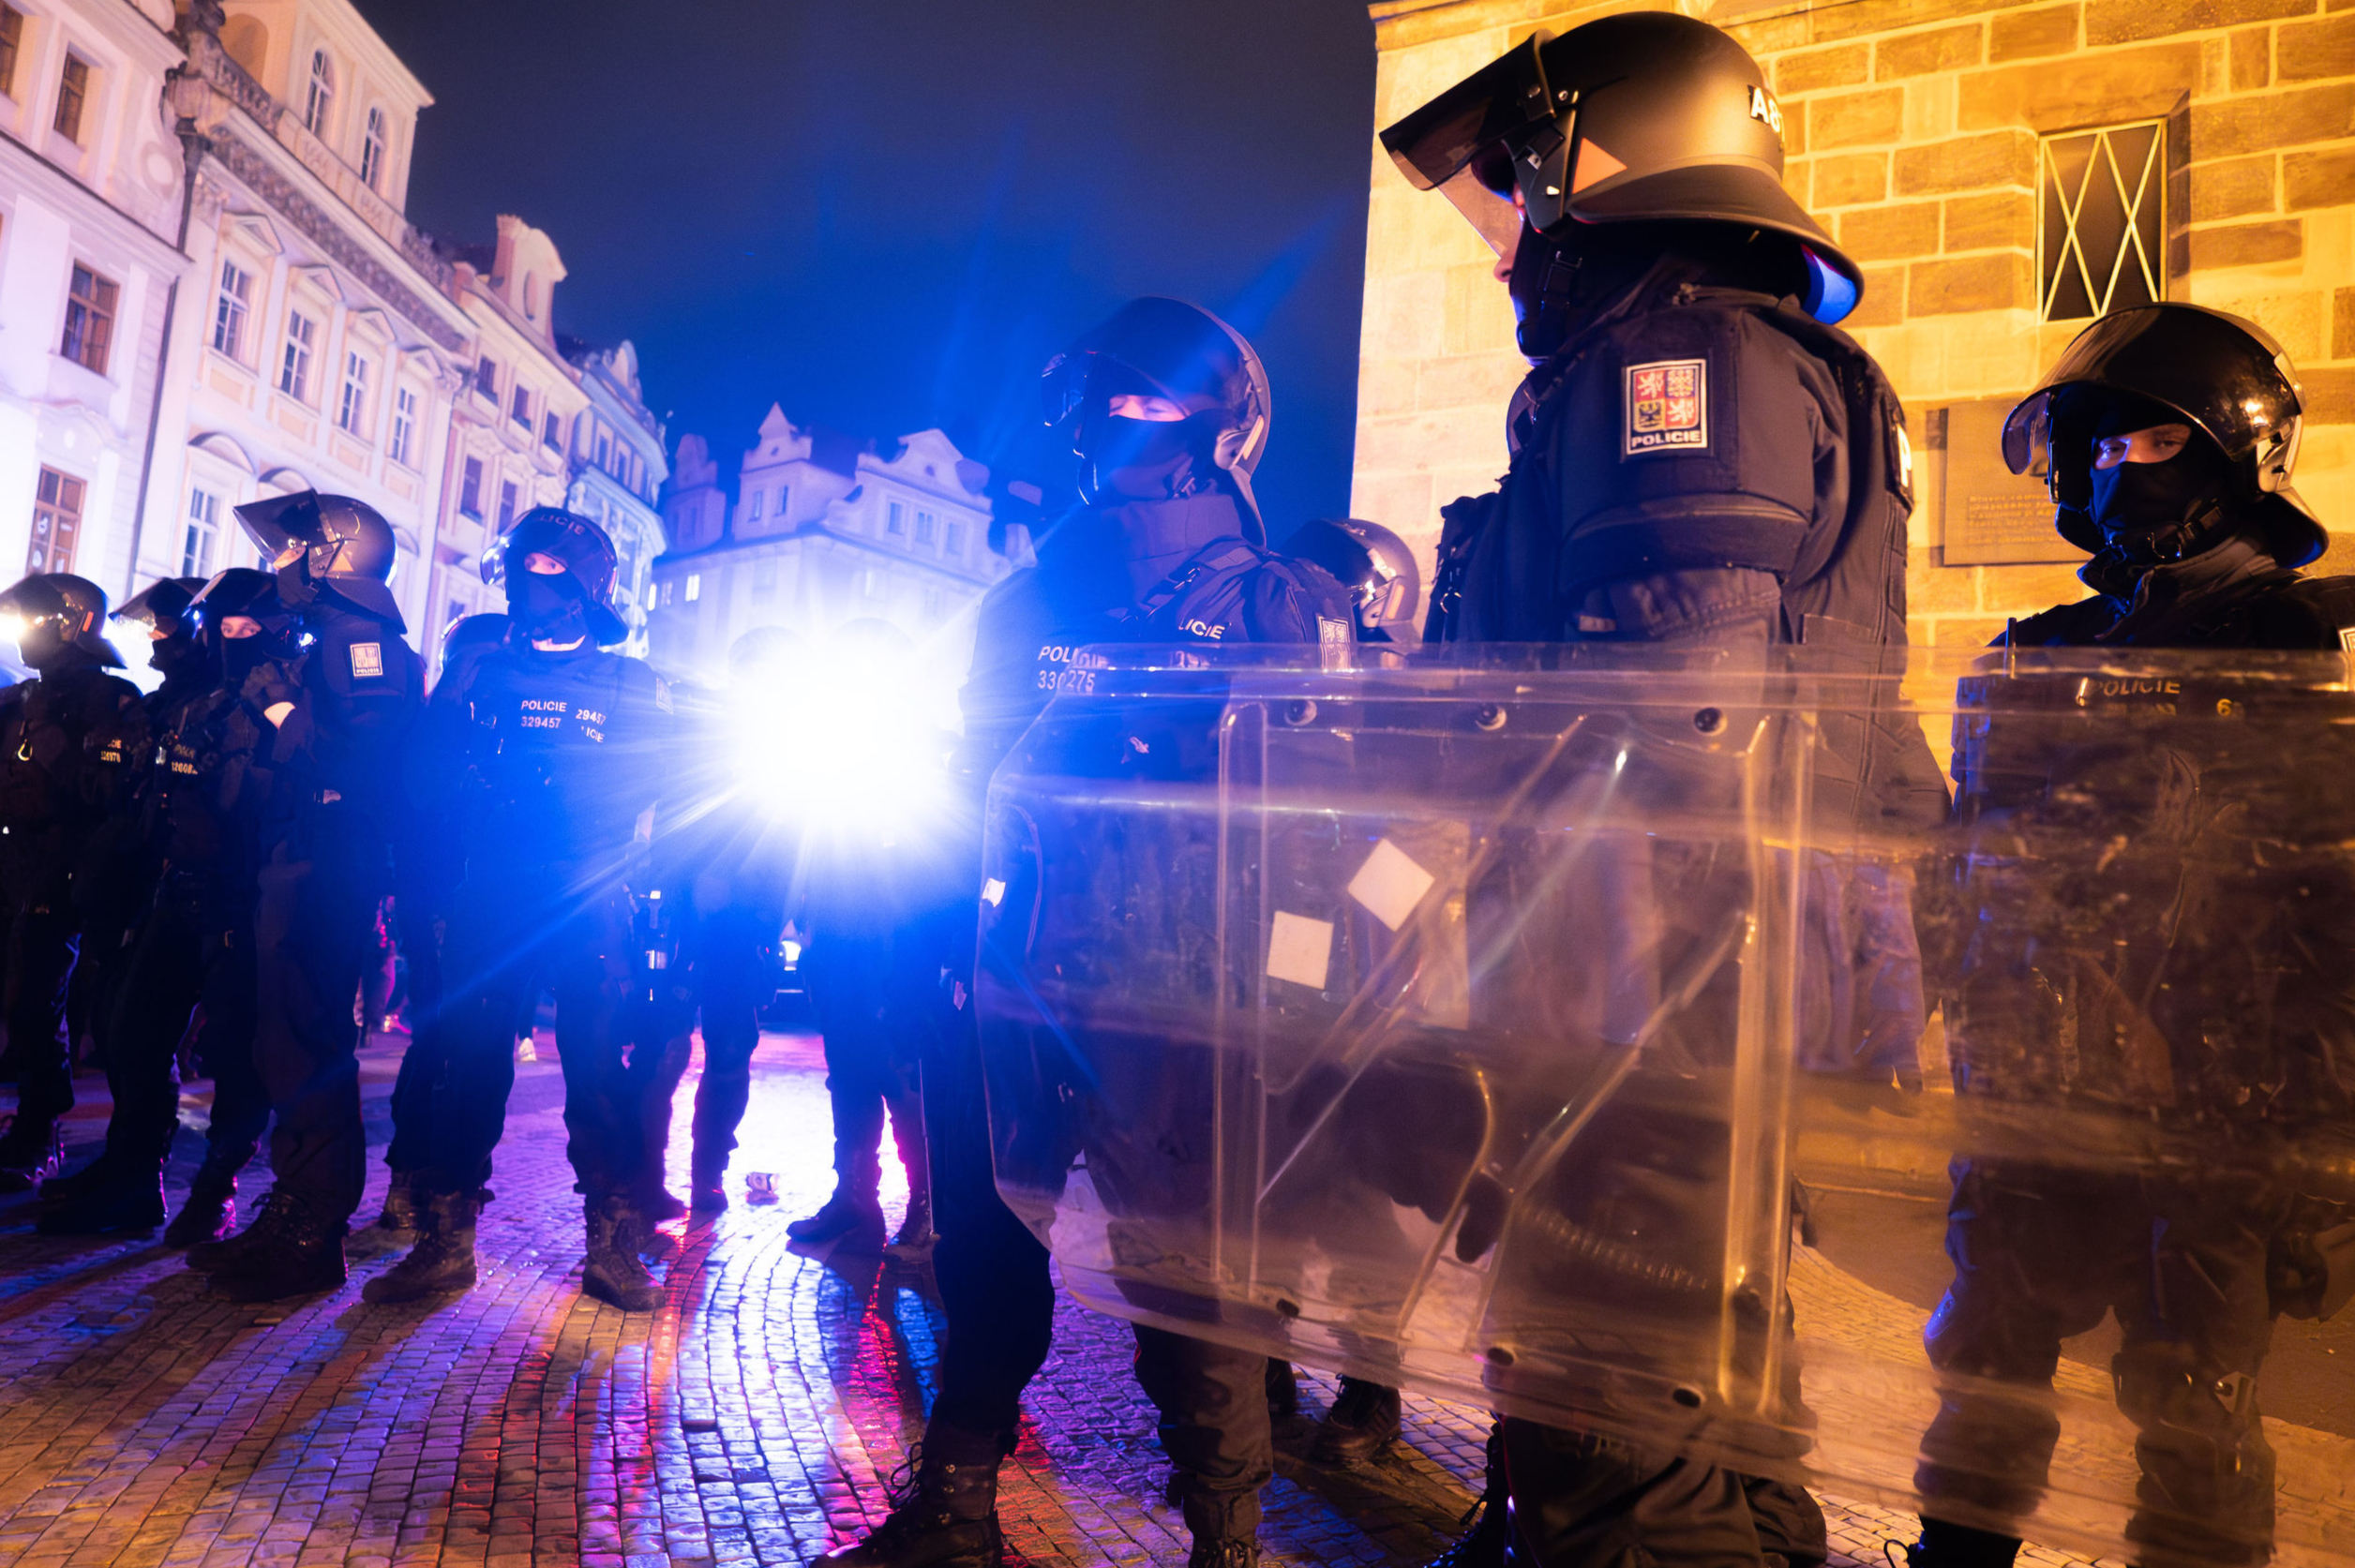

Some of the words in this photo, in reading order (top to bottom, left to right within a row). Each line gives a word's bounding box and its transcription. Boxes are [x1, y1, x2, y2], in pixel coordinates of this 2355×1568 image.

[1631, 430, 1702, 448] POLICIE
[1178, 619, 1225, 639] ICIE
[520, 700, 567, 712] POLICIE
[520, 716, 562, 729] 329457
